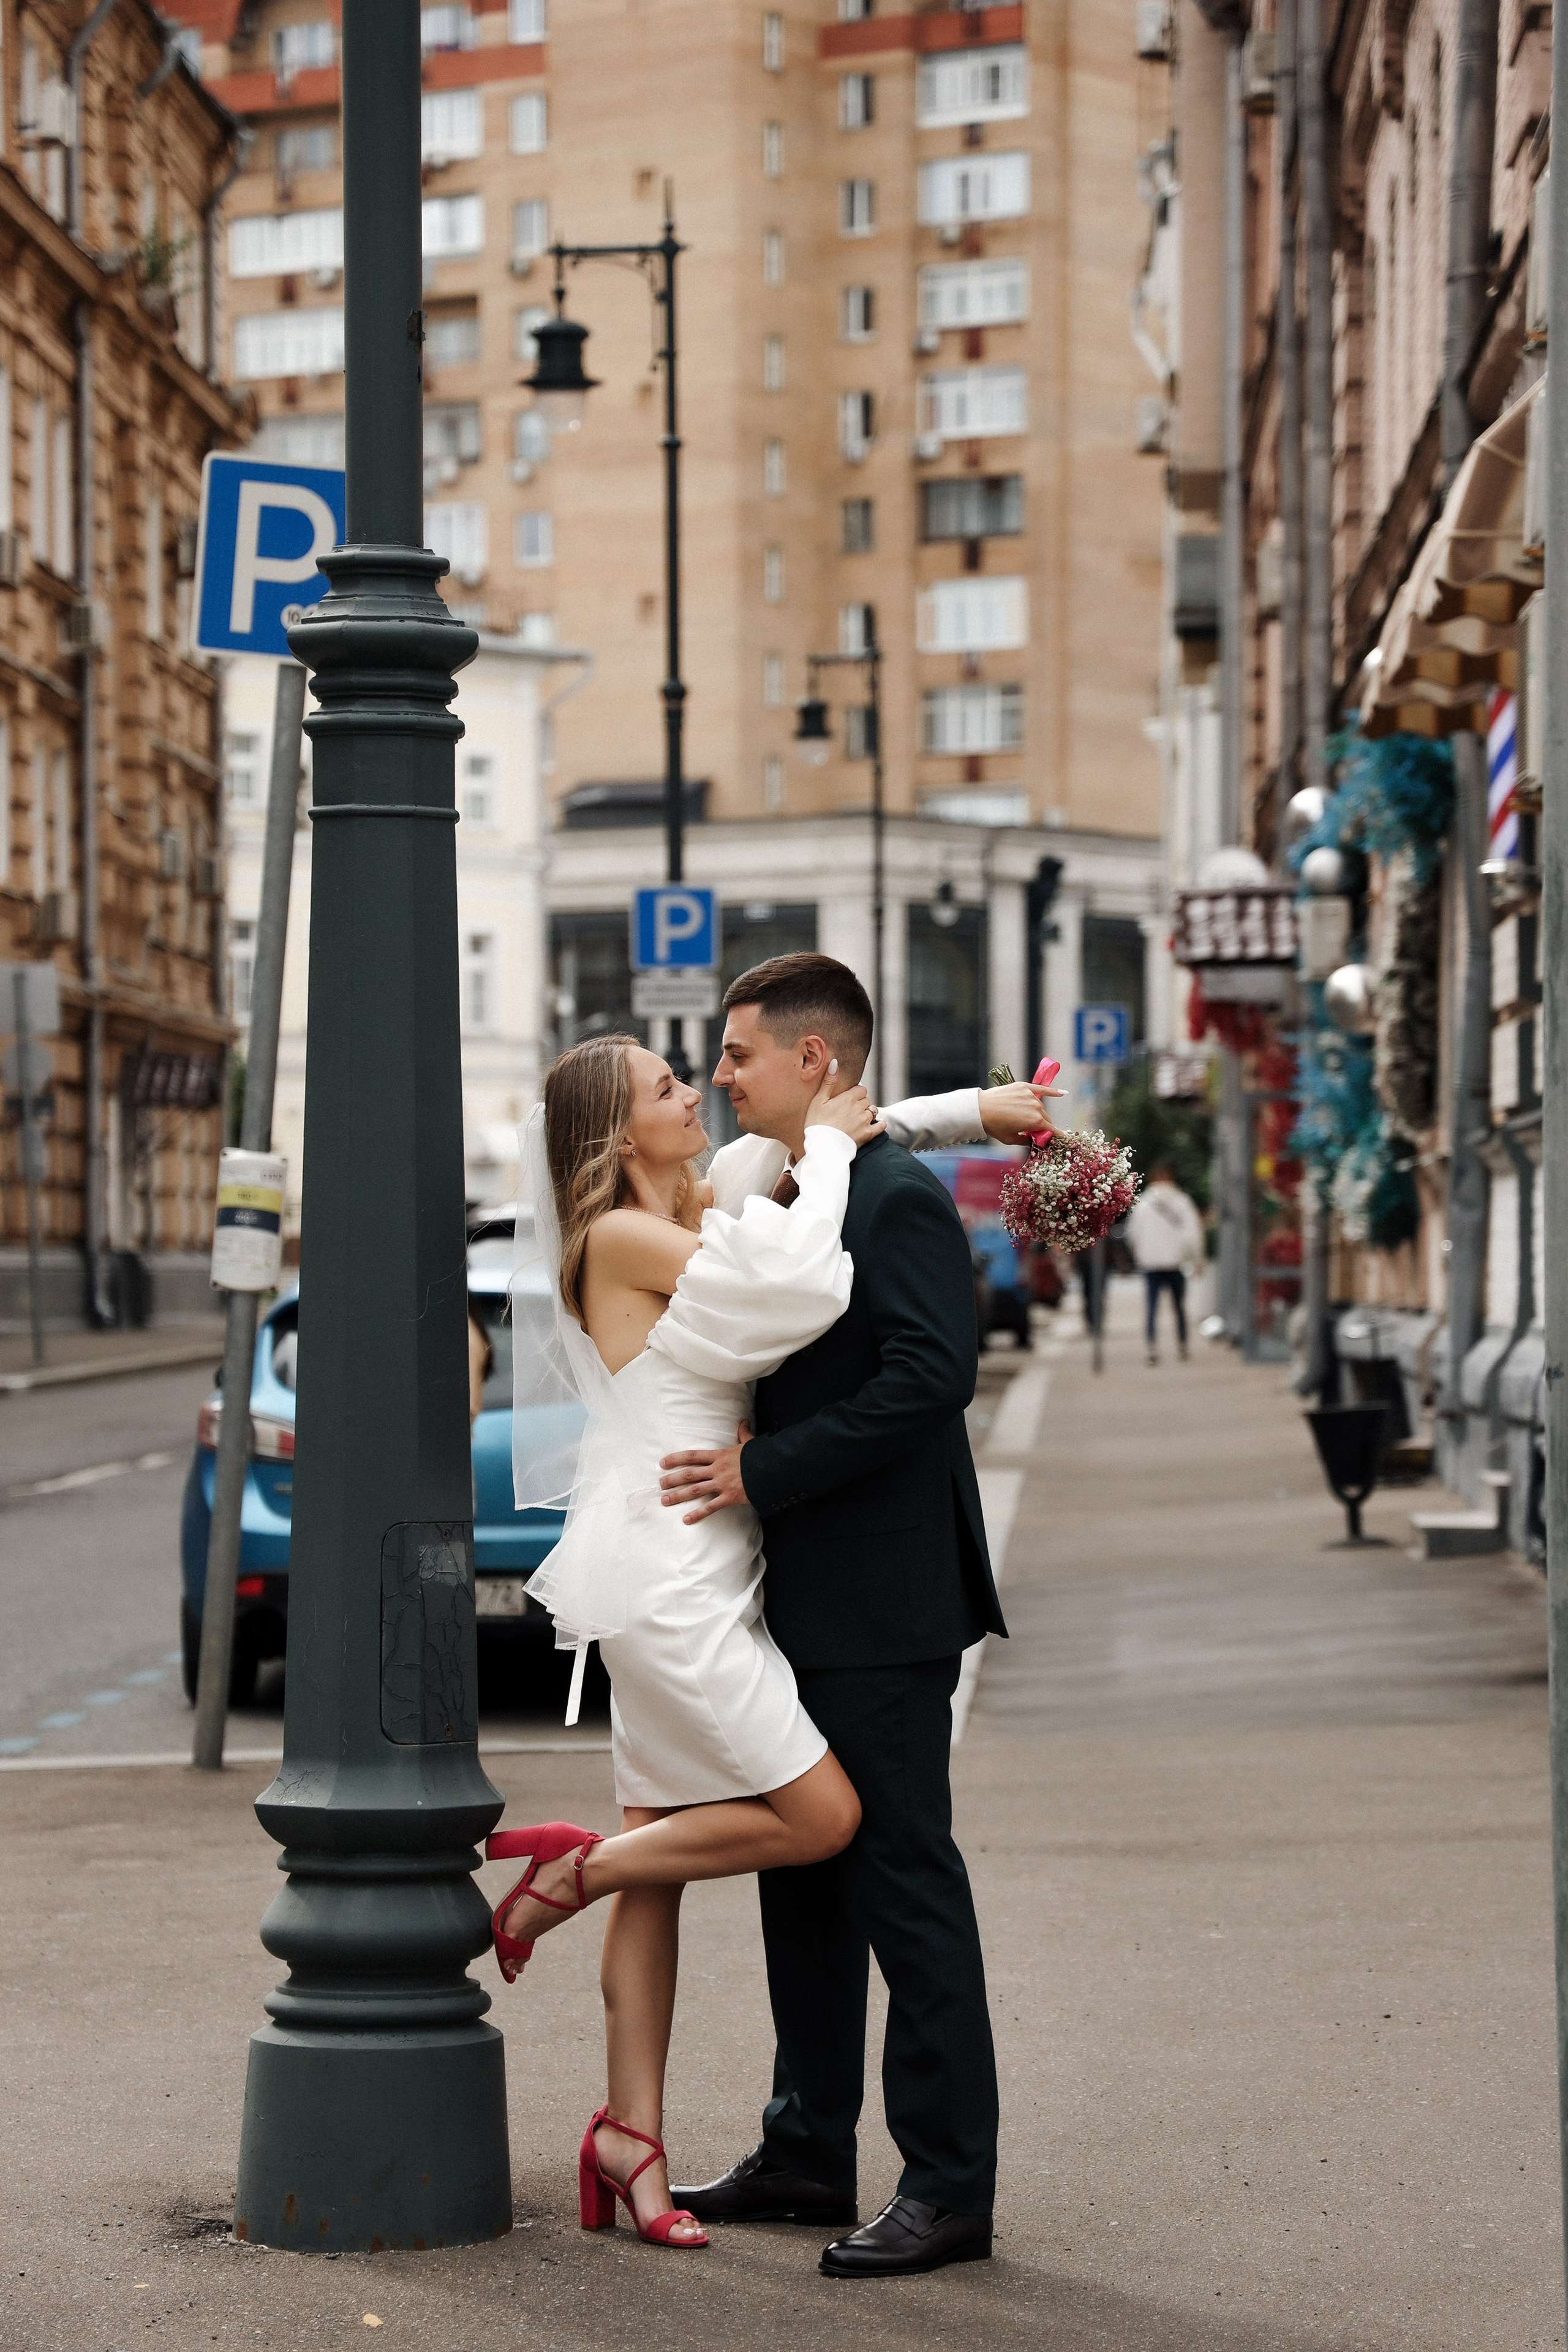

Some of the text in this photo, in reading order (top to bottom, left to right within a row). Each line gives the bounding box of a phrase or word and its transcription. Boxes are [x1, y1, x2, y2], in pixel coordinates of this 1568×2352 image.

[229, 479, 337, 634] P
[654, 894, 704, 962] P
[1084, 1009, 1117, 1055] P
